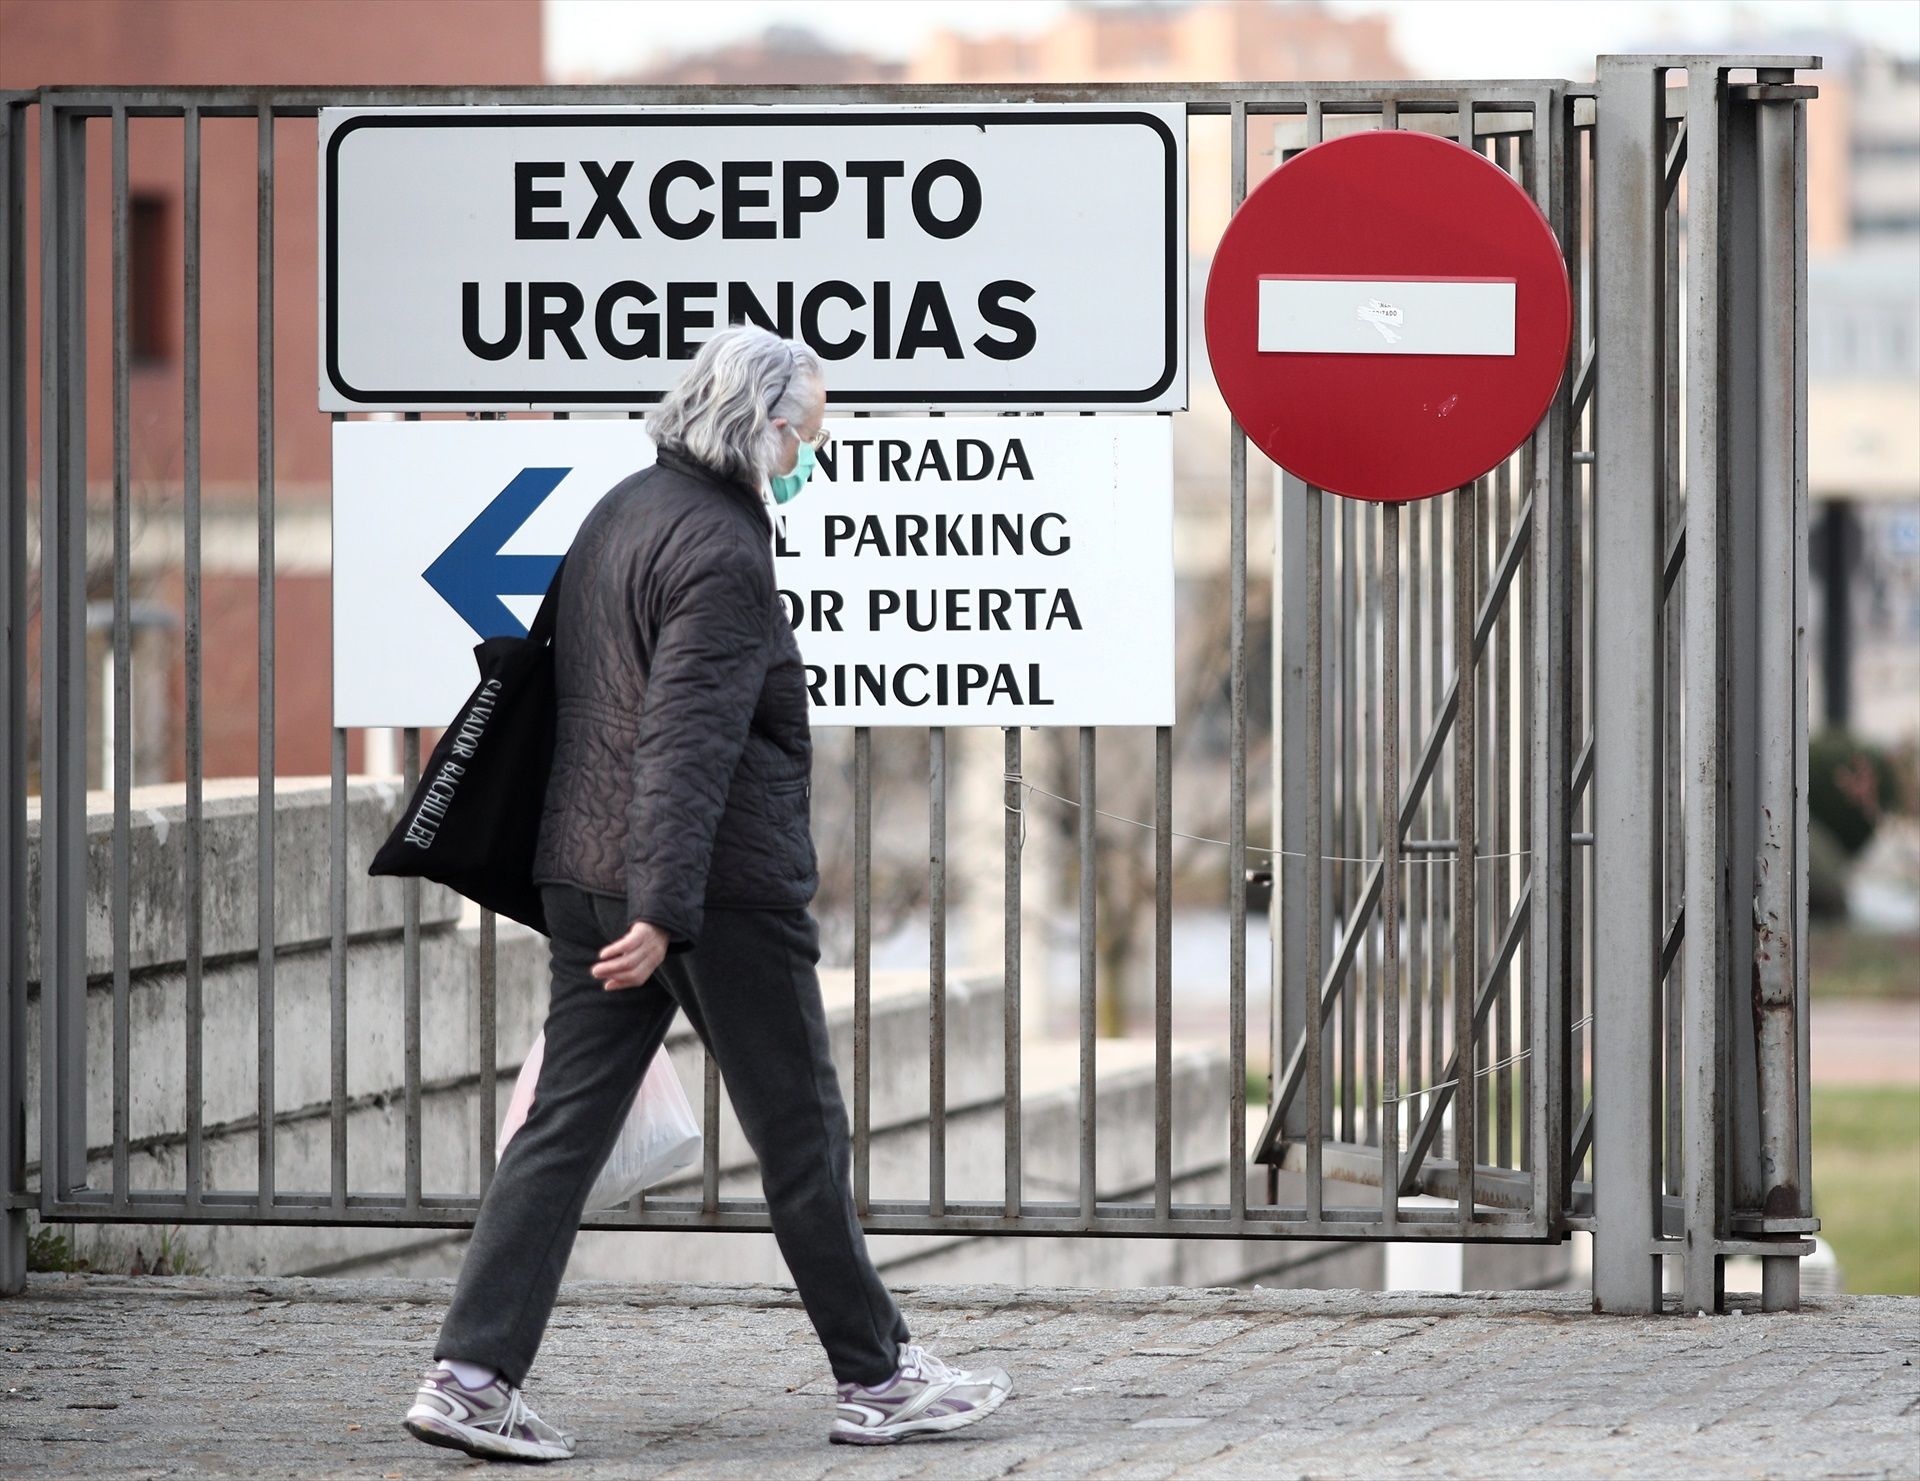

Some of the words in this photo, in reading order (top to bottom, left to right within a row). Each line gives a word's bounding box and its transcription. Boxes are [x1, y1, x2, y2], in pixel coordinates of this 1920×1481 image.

[514, 158, 983, 241] EXCEPTO
[462, 280, 1037, 361] URGENCIAS
[807, 438, 1034, 483] NTRADA
[775, 514, 801, 557] L
[824, 512, 1072, 557] PARKING
[777, 589, 844, 632] OR
[869, 588, 1083, 632] PUERTA
[804, 663, 1055, 707] RINCIPAL
[404, 762, 466, 849] BACHILLER
